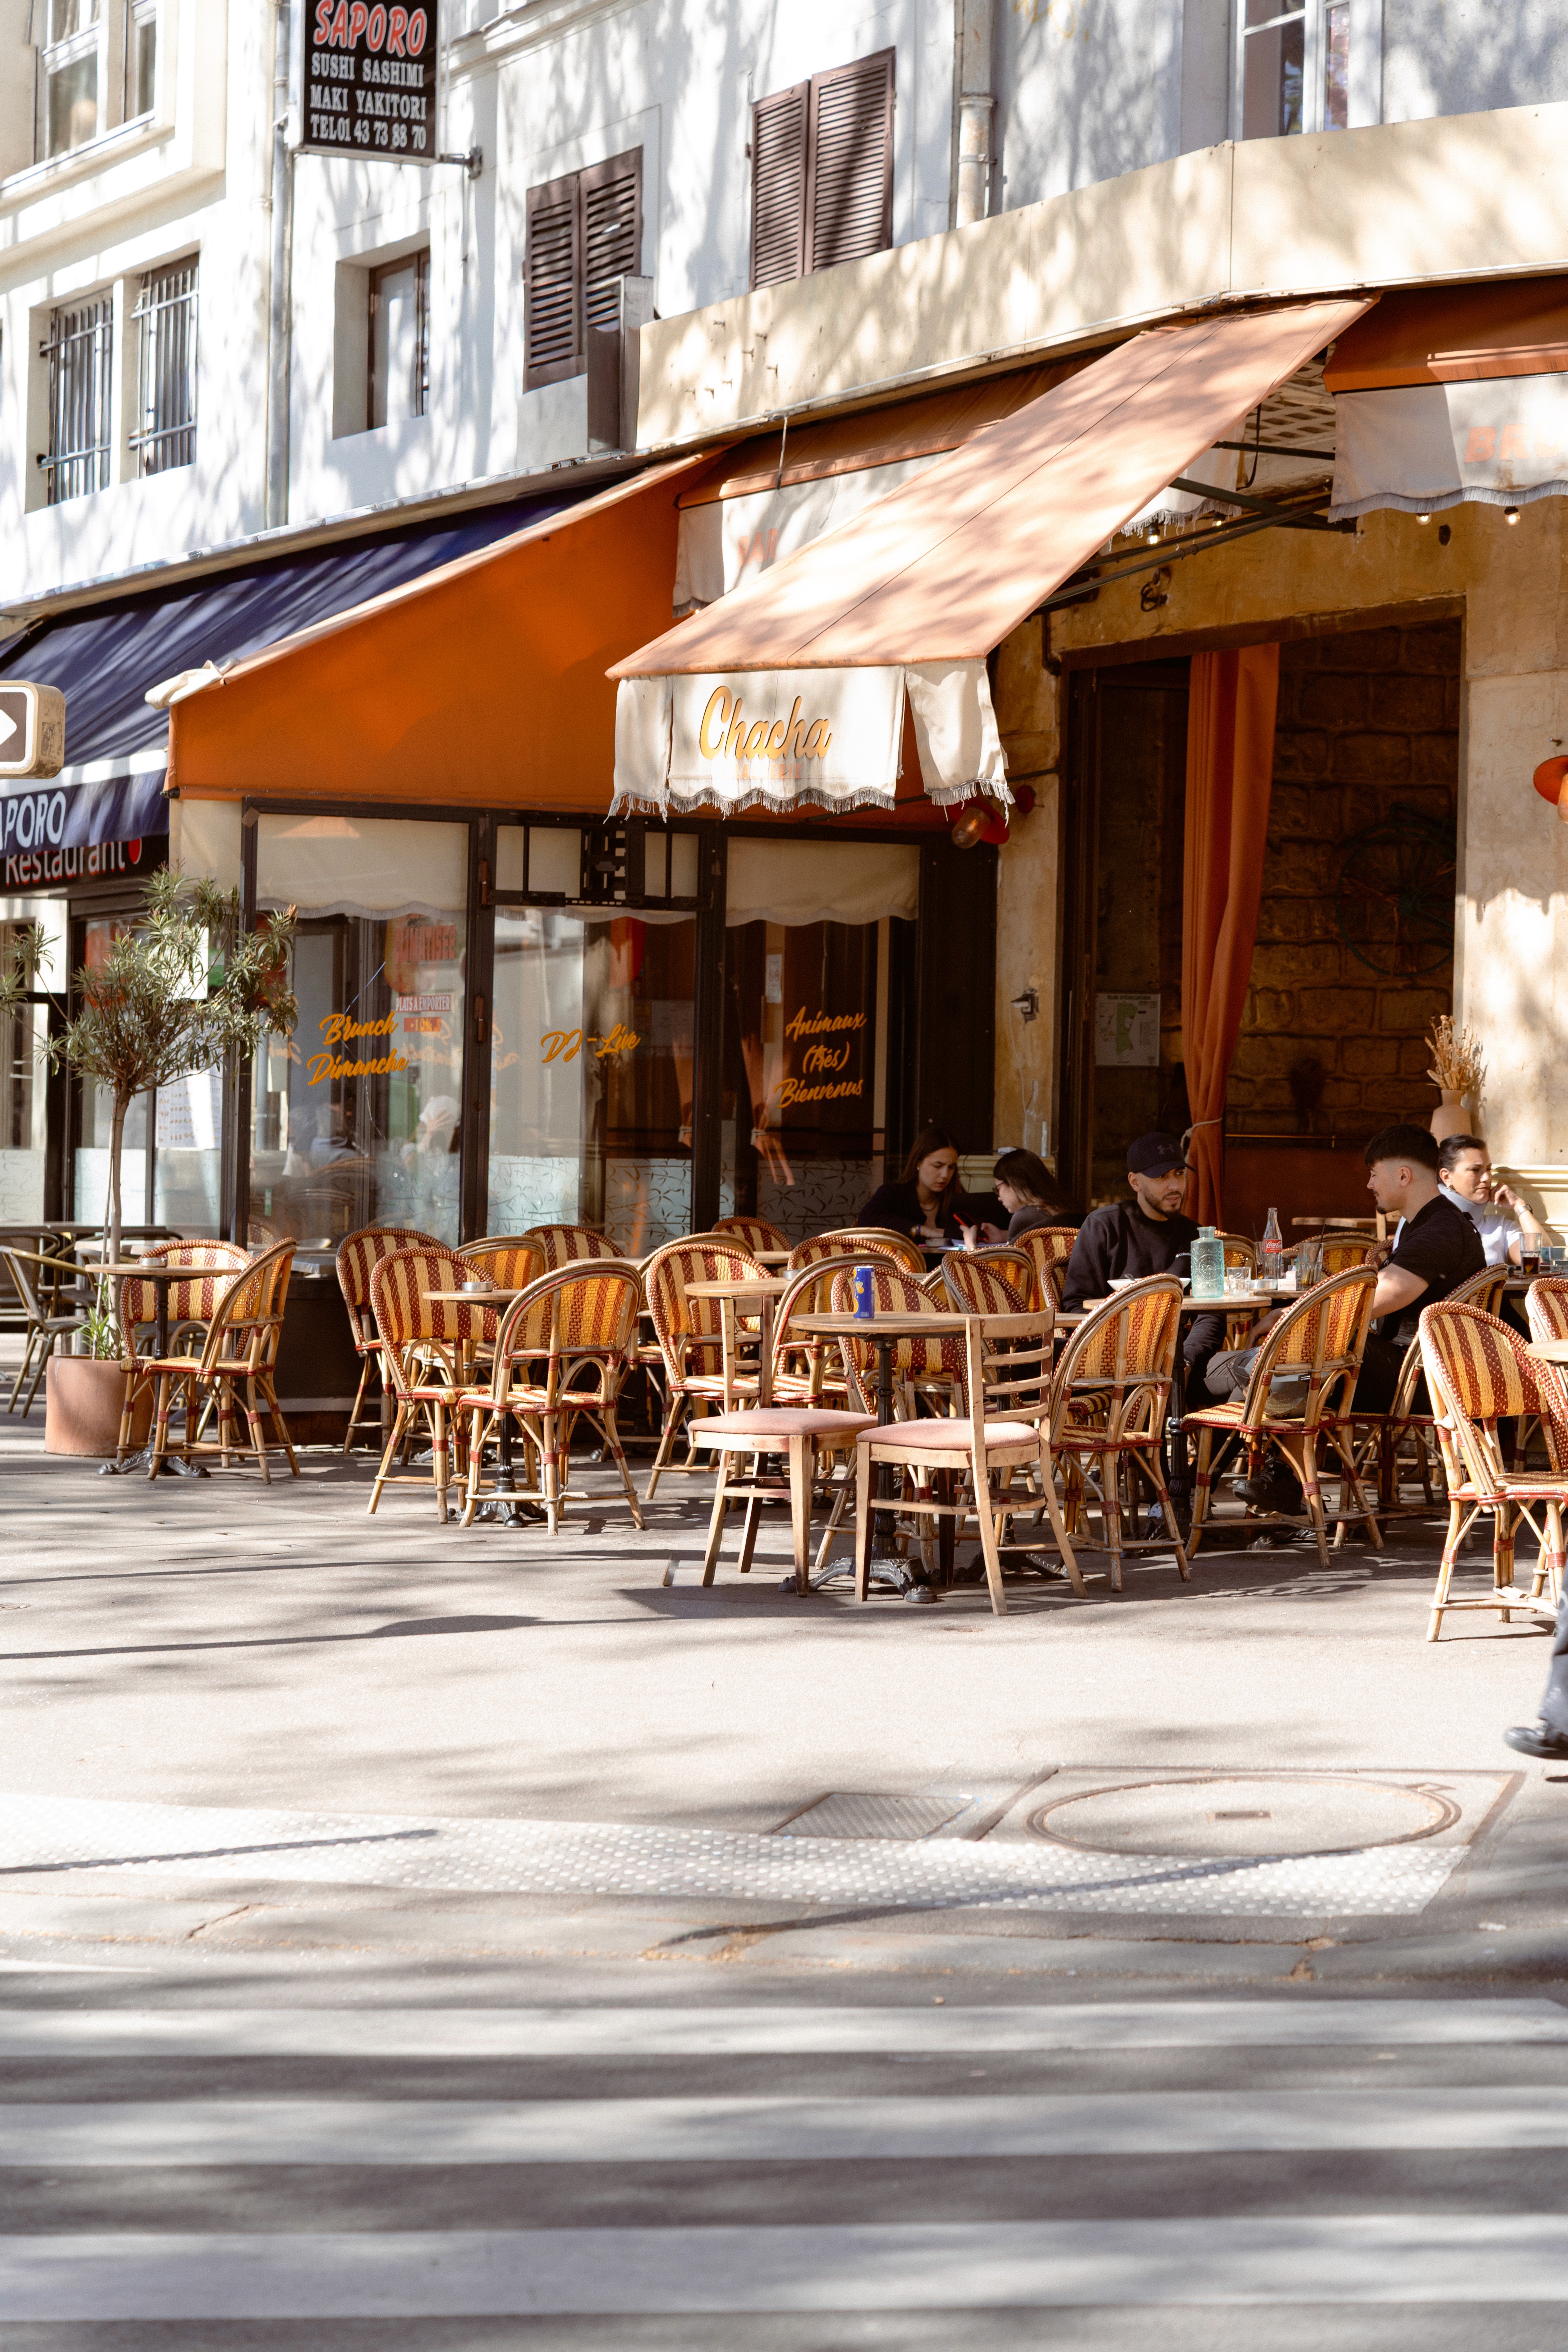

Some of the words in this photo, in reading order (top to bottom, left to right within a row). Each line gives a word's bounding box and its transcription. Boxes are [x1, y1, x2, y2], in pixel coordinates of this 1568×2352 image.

[314, 0, 427, 58] SAPORO
[311, 52, 355, 80] SUSHI
[362, 58, 425, 88] SASHIMI
[310, 84, 348, 112] MAKI
[356, 89, 427, 120] YAKITORI
[354, 119, 370, 144] 43
[374, 120, 389, 146] 73
[392, 122, 408, 148] 88
[412, 124, 426, 150] 70
[738, 528, 779, 567] BAR
[699, 685, 833, 760] Chacha
[0, 790, 66, 851] PORO
[5, 841, 125, 887] Restaurant
[396, 997, 413, 1011] PLATS
[419, 996, 450, 1011] EMPORTER
[319, 1010, 399, 1045] Brunch
[595, 1023, 641, 1058] Live
[785, 1005, 867, 1042] Animaux
[306, 1047, 410, 1086] Dimanche
[773, 1078, 864, 1109] Bienvenus
